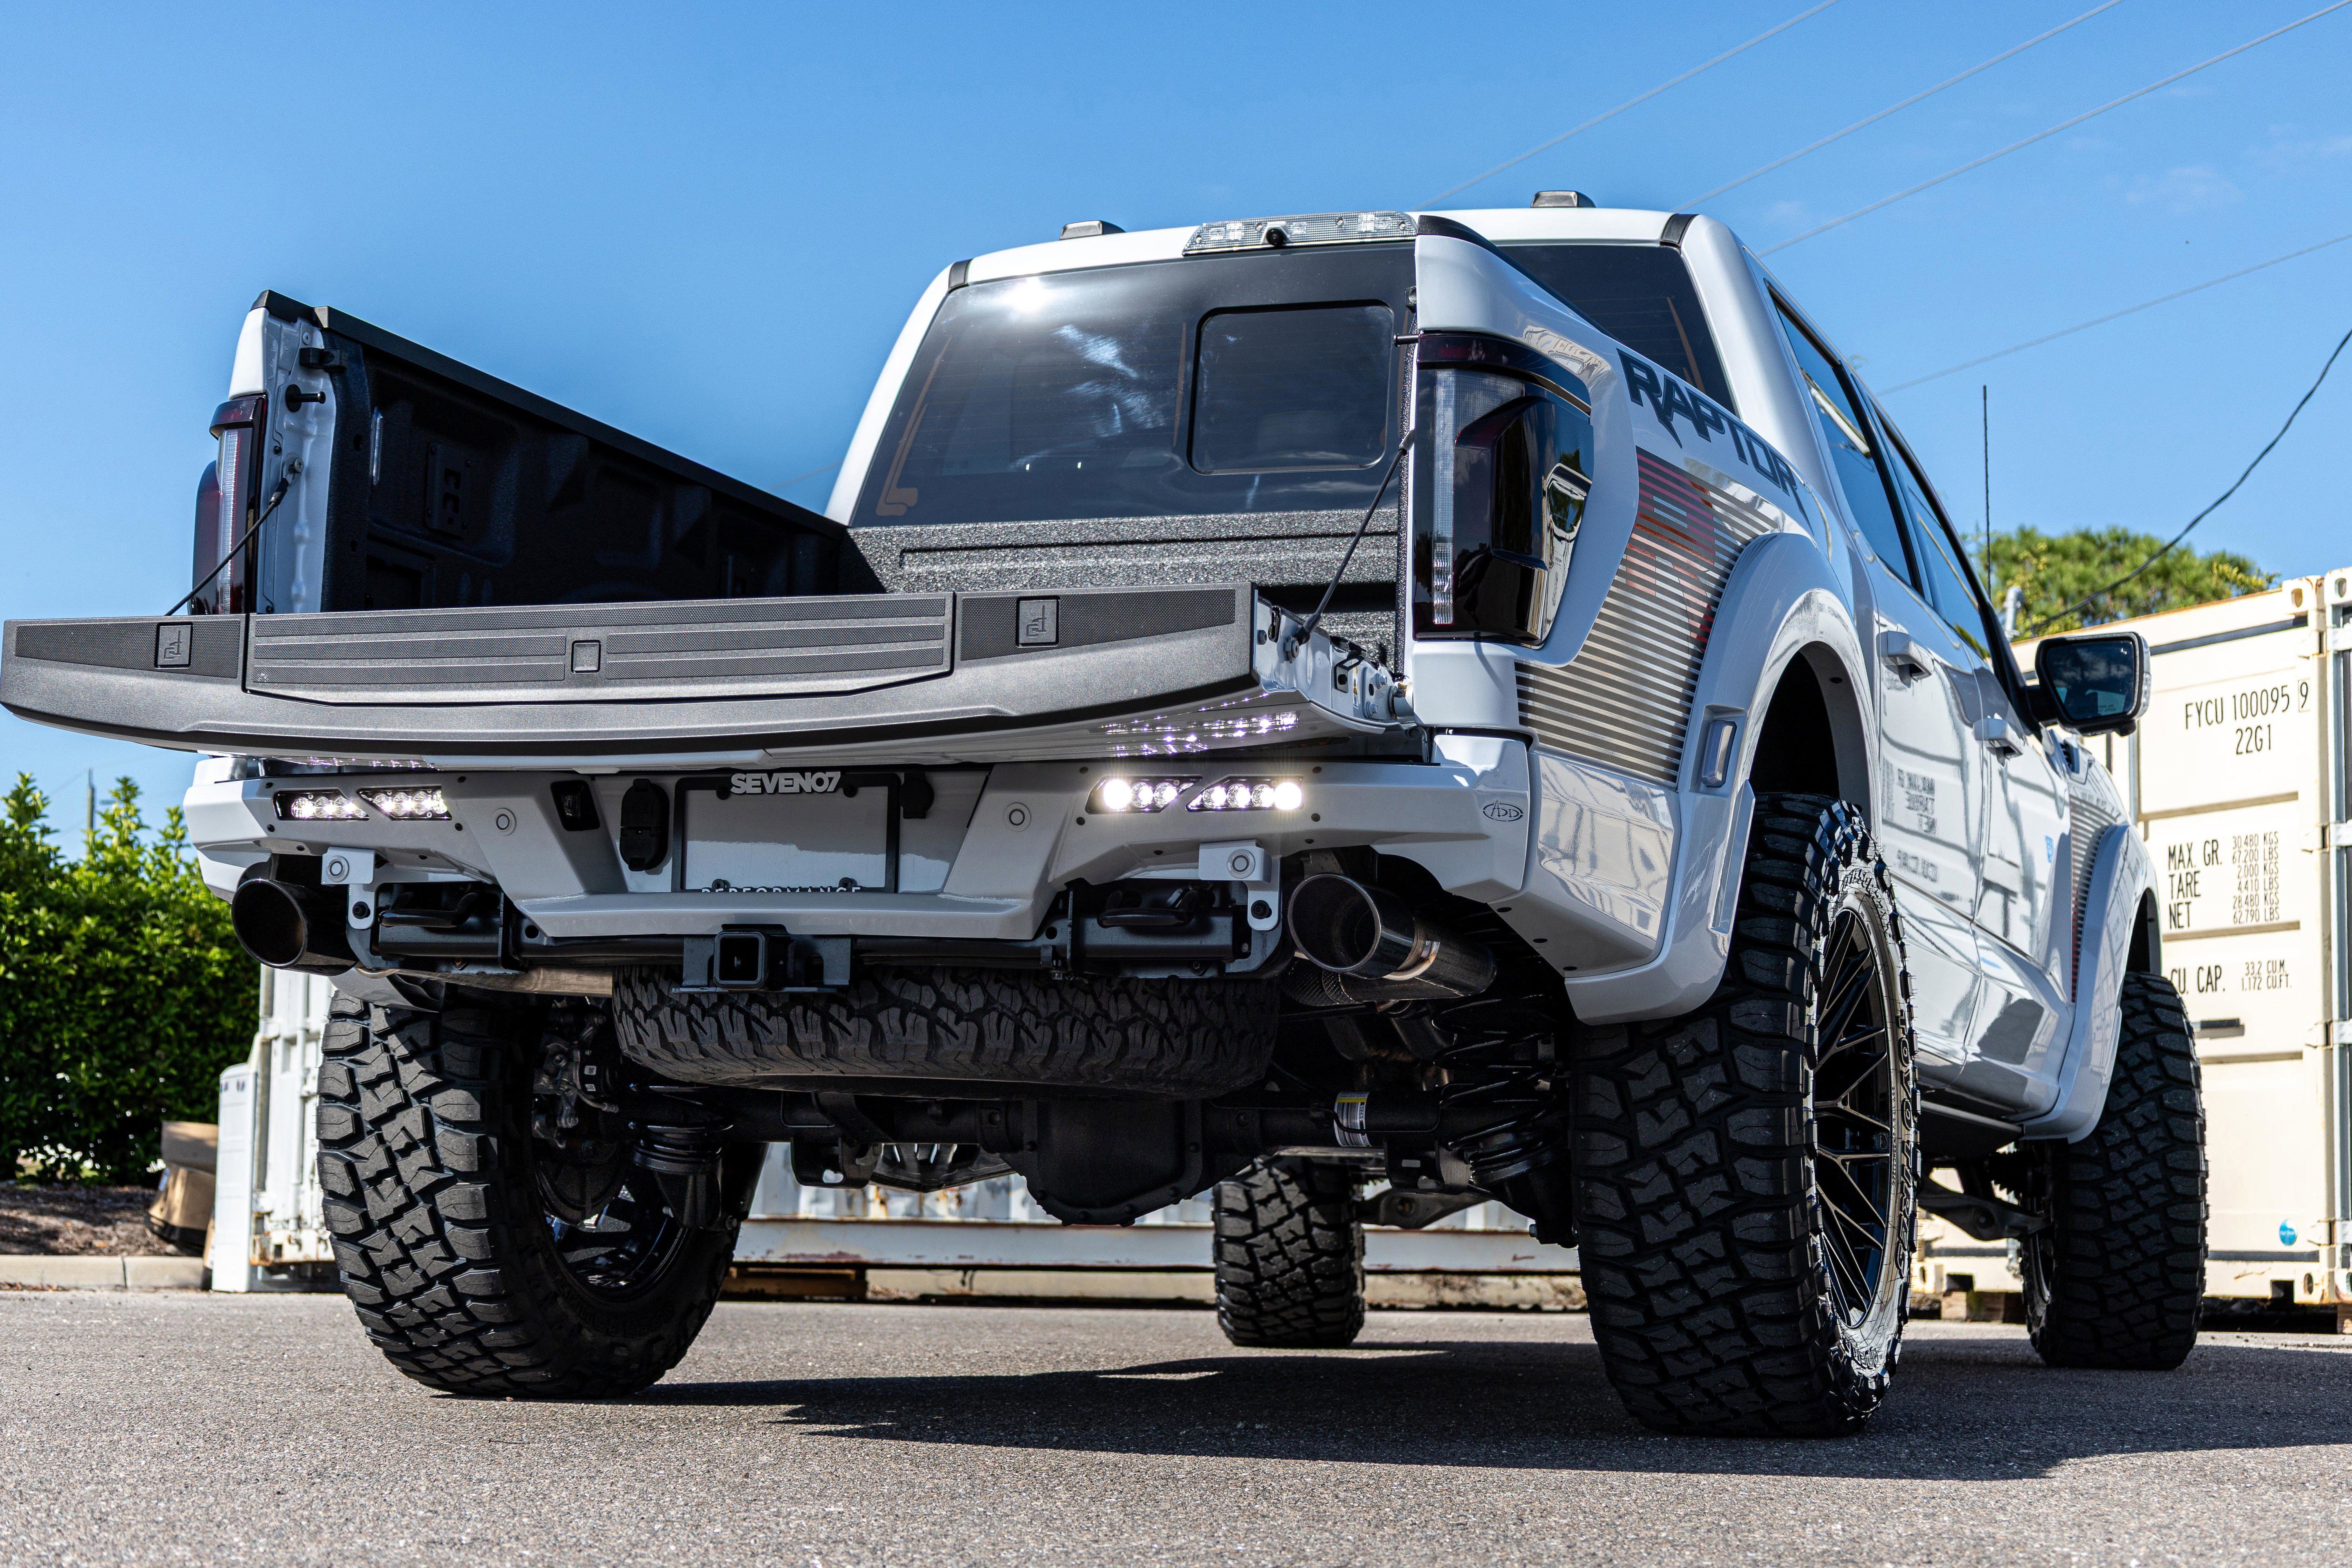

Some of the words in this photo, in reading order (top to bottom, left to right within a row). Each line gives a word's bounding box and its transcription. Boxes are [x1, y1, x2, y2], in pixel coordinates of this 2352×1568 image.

[1616, 348, 1815, 537] RAPTOR
[2185, 697, 2223, 730] FYCU
[2233, 684, 2290, 720] 100095
[2300, 682, 2309, 709] 9
[2236, 724, 2271, 755] 22G1
[2168, 842, 2196, 871] MAX.
[2203, 839, 2223, 866] GR.
[2263, 831, 2279, 845] KGS
[2263, 846, 2279, 861] LBS
[2169, 871, 2201, 900] TARE
[2263, 861, 2279, 875] KGS
[2264, 876, 2279, 891] LBS
[2169, 901, 2192, 930] NET
[2264, 891, 2280, 906] KGS
[2264, 906, 2280, 922] LBS
[2197, 964, 2225, 993] CAP.
